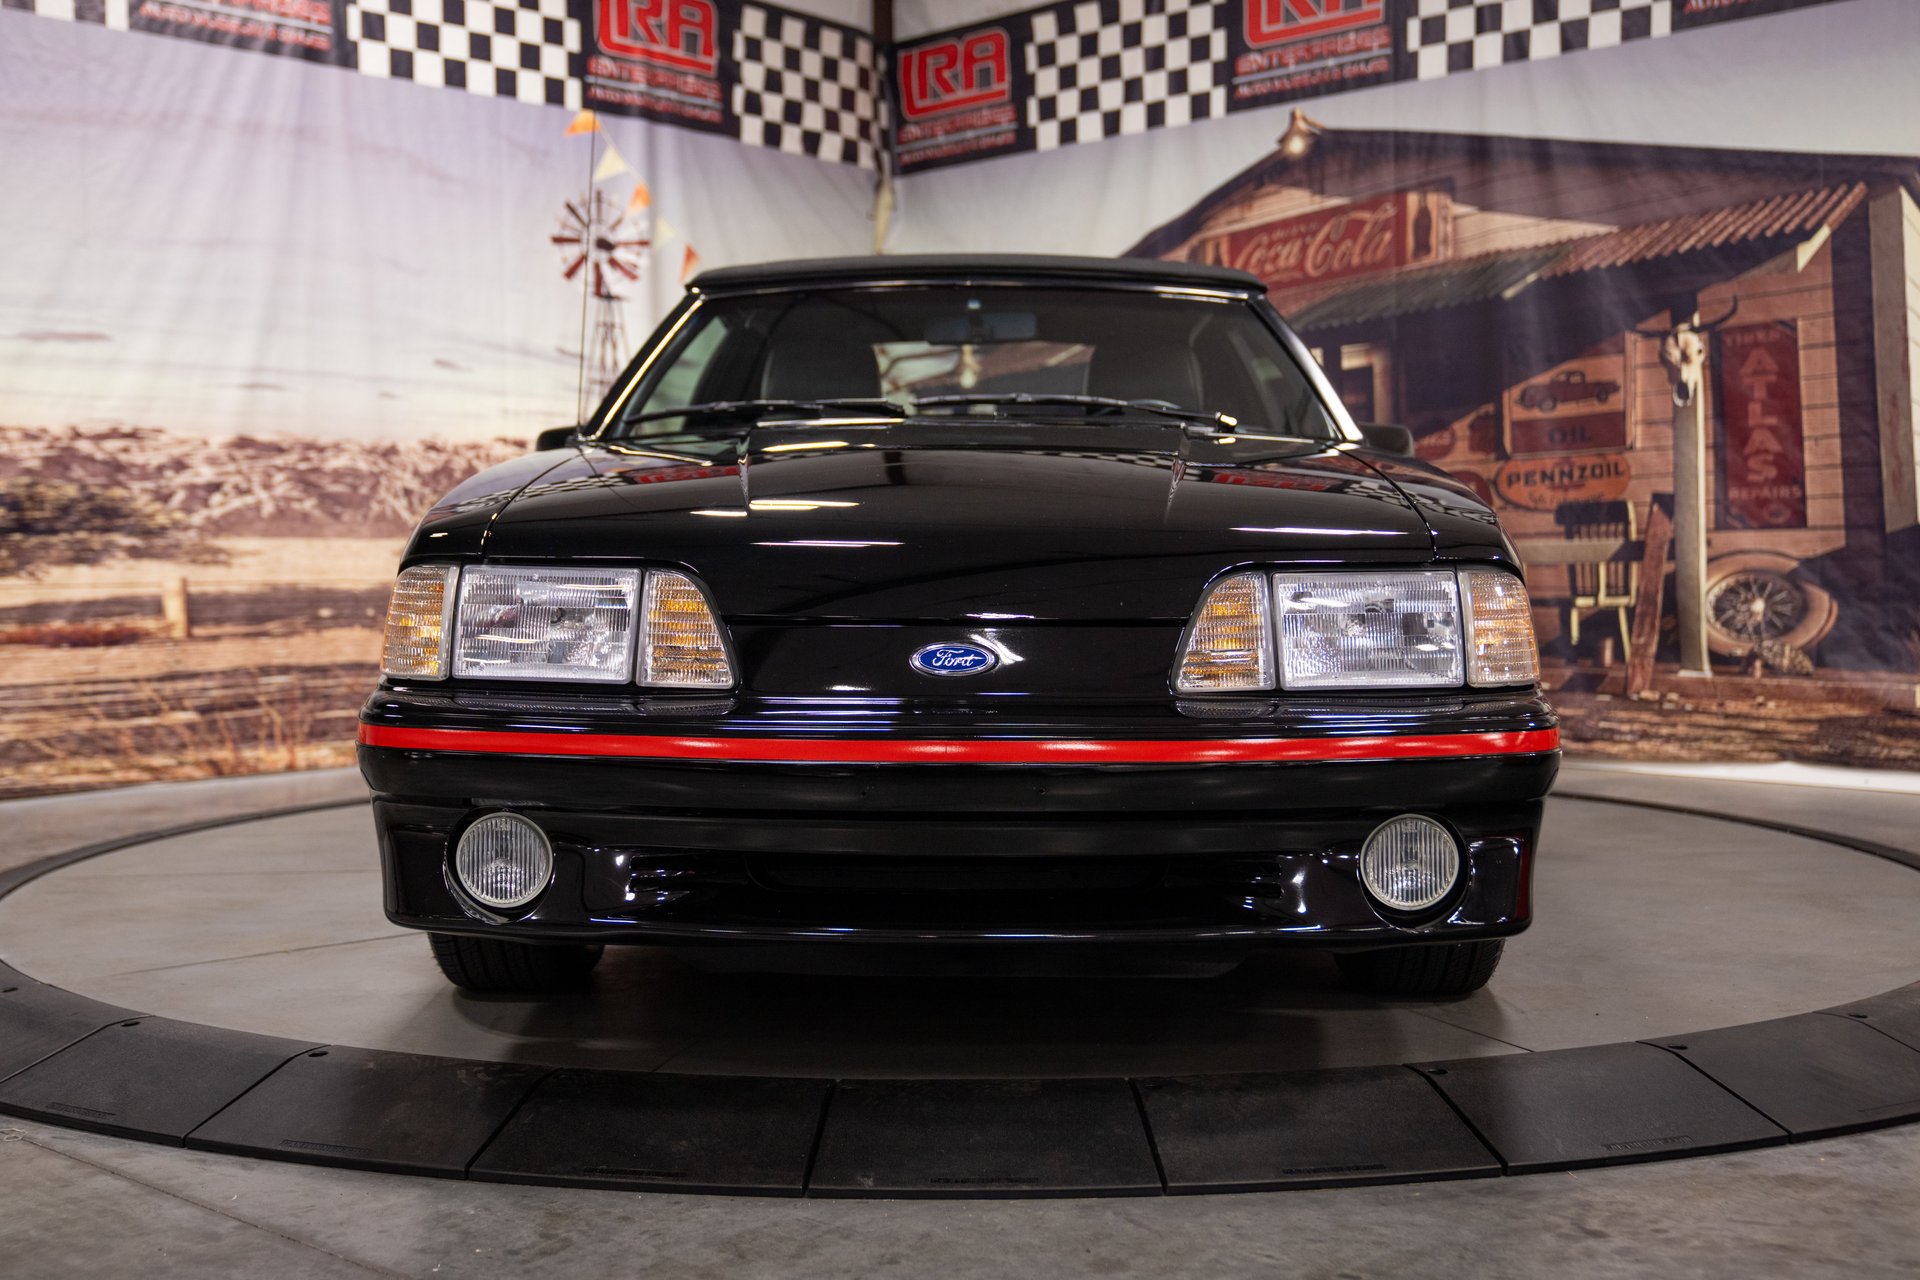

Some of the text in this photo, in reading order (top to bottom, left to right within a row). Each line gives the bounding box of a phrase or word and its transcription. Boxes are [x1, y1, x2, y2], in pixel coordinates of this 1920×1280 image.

[1740, 346, 1784, 483] ATLAS
[1548, 424, 1592, 445] OIL
[1506, 460, 1625, 489] PENNZOIL
[931, 648, 978, 667] Ford
